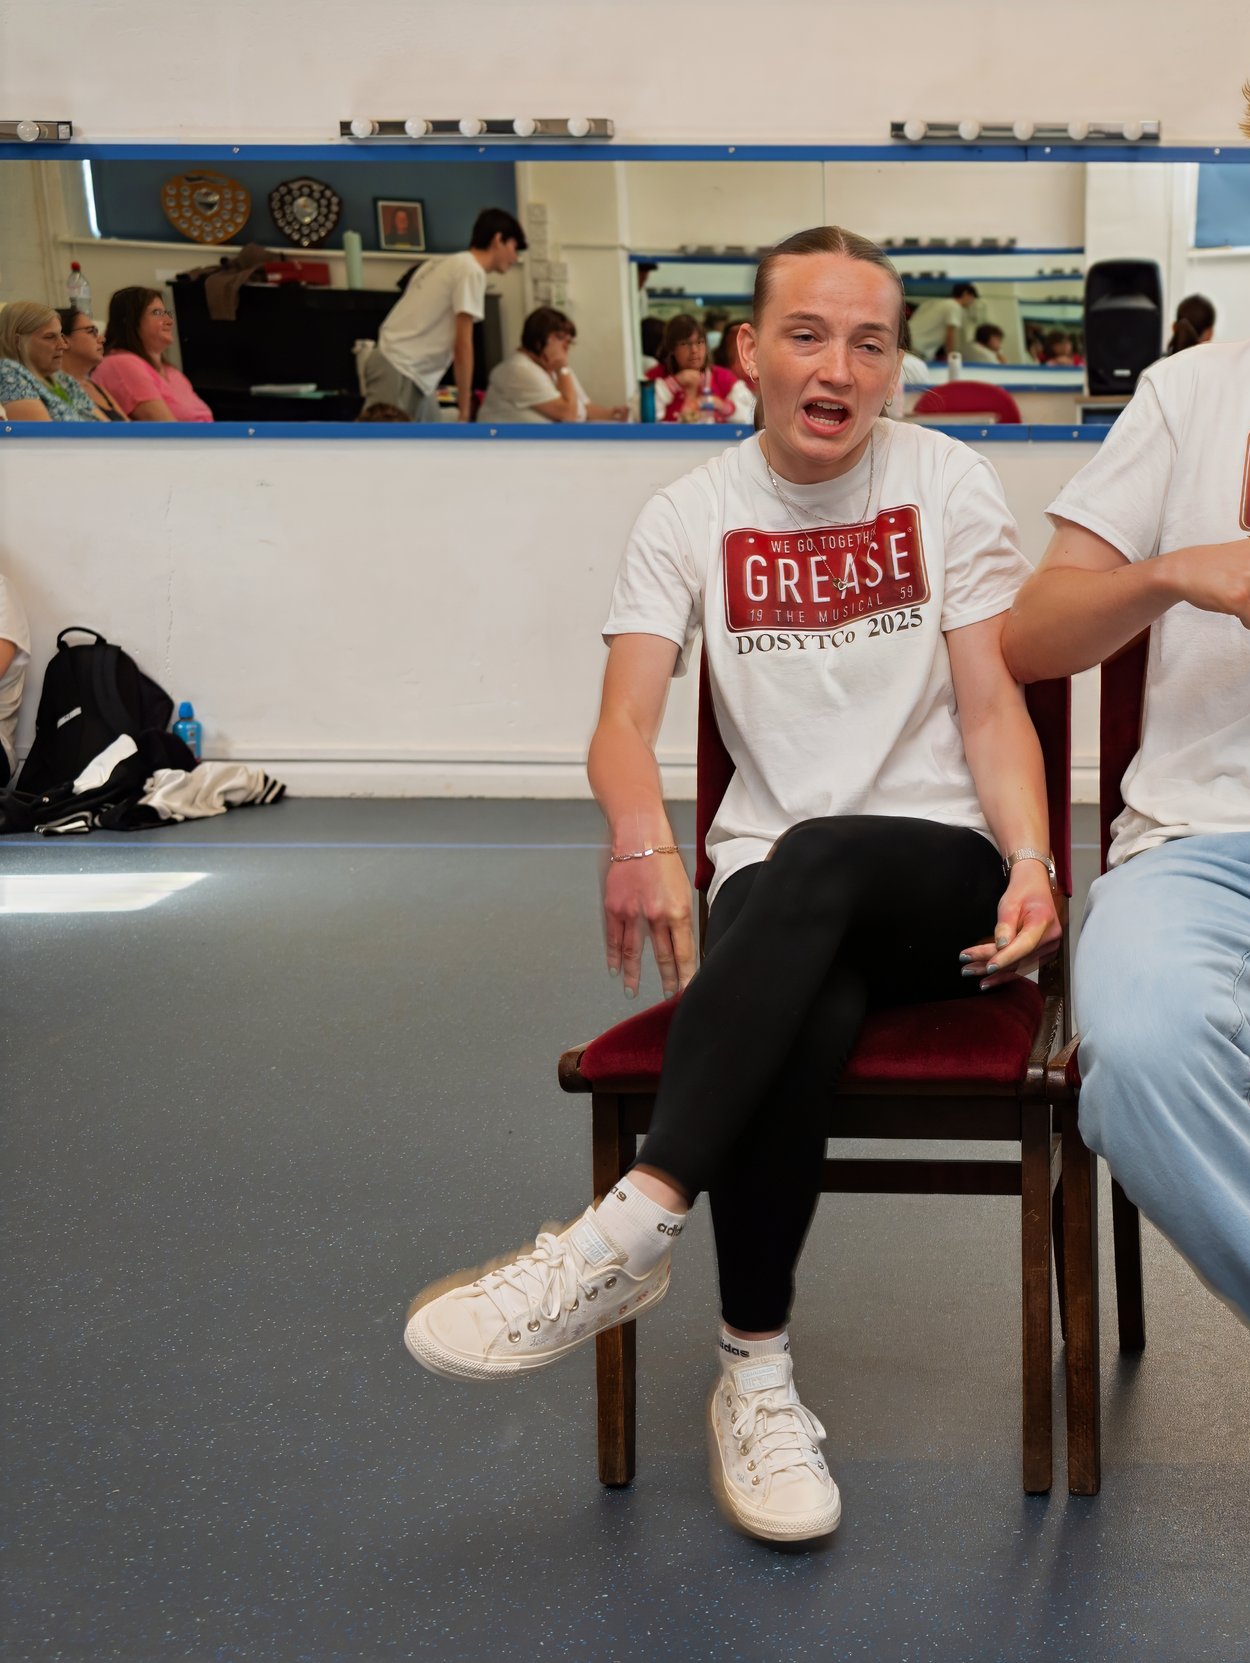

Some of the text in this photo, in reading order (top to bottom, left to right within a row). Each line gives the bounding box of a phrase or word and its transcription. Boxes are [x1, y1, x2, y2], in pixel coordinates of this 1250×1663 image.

[745, 531, 911, 604] GREASE
[771, 540, 790, 554] WE
[797, 538, 814, 552] GO
[750, 584, 914, 623] 19 THE MUSICAL 59
[736, 607, 923, 655] DOSYTCo 2025
